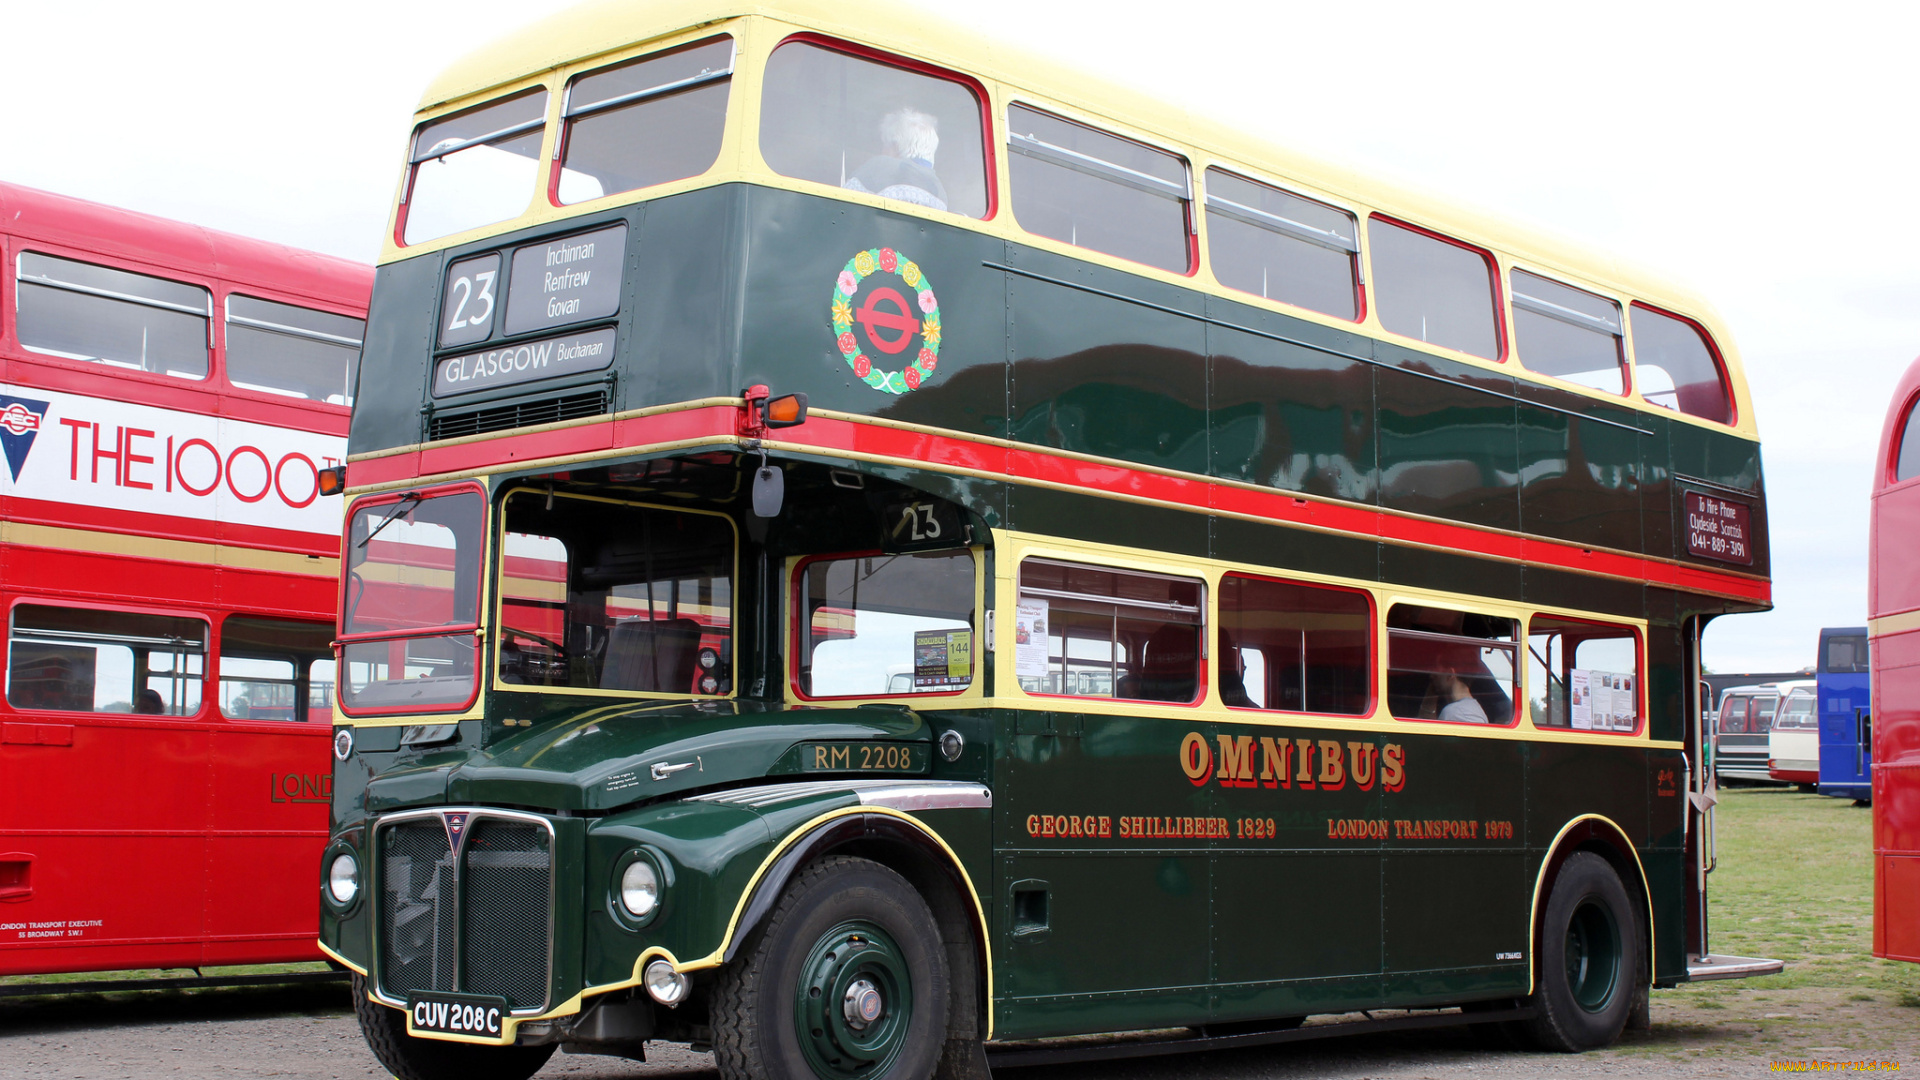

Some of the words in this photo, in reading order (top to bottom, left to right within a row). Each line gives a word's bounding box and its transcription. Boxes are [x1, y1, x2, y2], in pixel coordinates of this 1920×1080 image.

[546, 243, 594, 266] Inchinnan
[544, 268, 591, 293] Renfrew
[448, 270, 496, 330] 23
[548, 296, 580, 318] Govan
[445, 342, 553, 382] GLASGOW
[557, 341, 603, 362] Buchanan
[0, 412, 36, 426] AEC
[60, 417, 155, 490] THE
[1699, 496, 1704, 512] To
[1707, 499, 1718, 514] Hire
[1720, 502, 1736, 519] Phone
[902, 504, 941, 540] 23
[1690, 513, 1718, 533] Clydeside
[1720, 520, 1742, 539] Scottish
[950, 642, 968, 654] 144
[815, 746, 850, 768] RM
[860, 746, 910, 769] 2208
[1180, 732, 1406, 792] OMNIBUS
[1026, 814, 1112, 838] GEORGE
[1119, 816, 1230, 838] SHILLIBEER
[1236, 818, 1276, 838] 1829
[1328, 818, 1390, 839] LONDON
[1394, 820, 1478, 839] TRANSPORT
[1484, 820, 1514, 839] 1979
[27, 930, 64, 938] BROADWAY
[29, 920, 66, 929] TRANSPORT
[68, 920, 103, 928] EXECUTIVE
